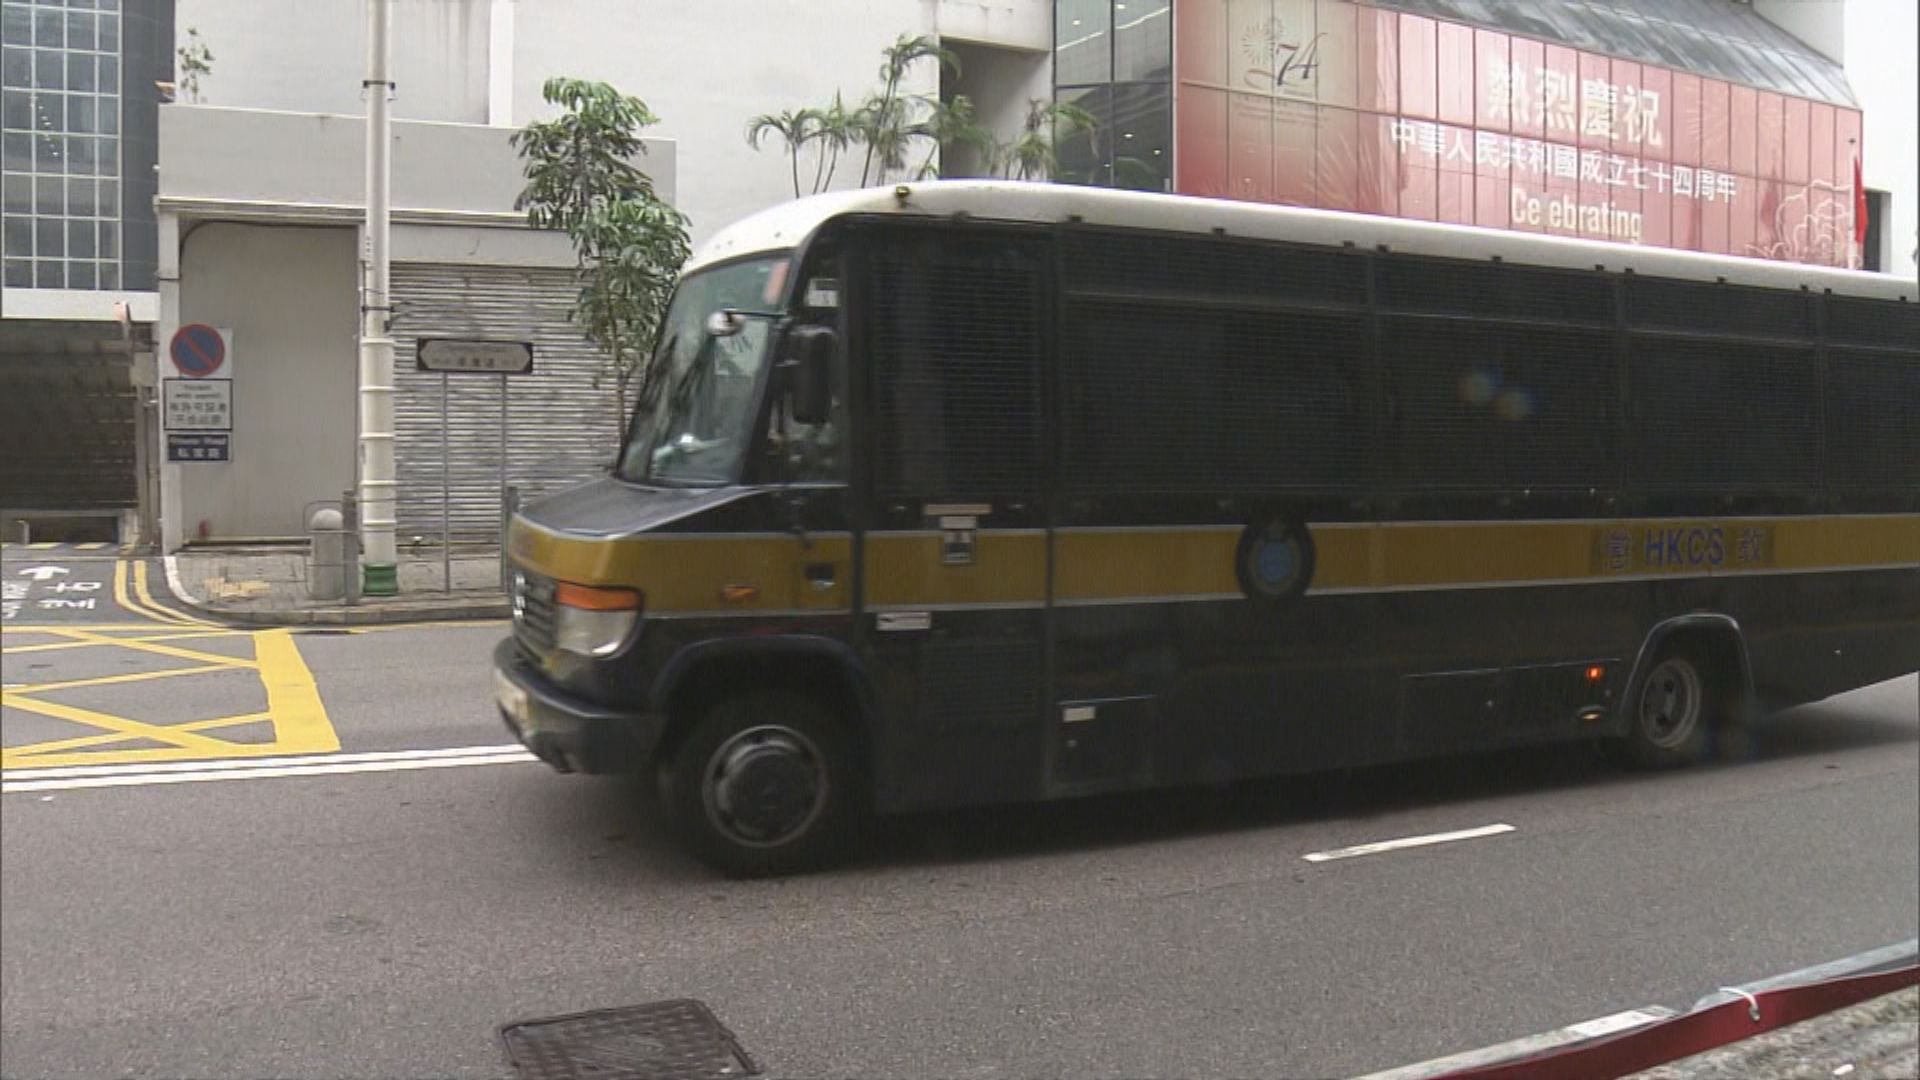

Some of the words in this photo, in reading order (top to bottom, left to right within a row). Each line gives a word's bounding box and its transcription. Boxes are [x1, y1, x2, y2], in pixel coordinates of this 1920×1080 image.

[1275, 31, 1328, 87] 74
[1486, 55, 1662, 146] 熱烈慶祝
[1390, 118, 1738, 203] 中華人民共和國成立七十四周年
[1510, 186, 1644, 244] Ceebrating
[1645, 527, 1725, 567] HKCS
